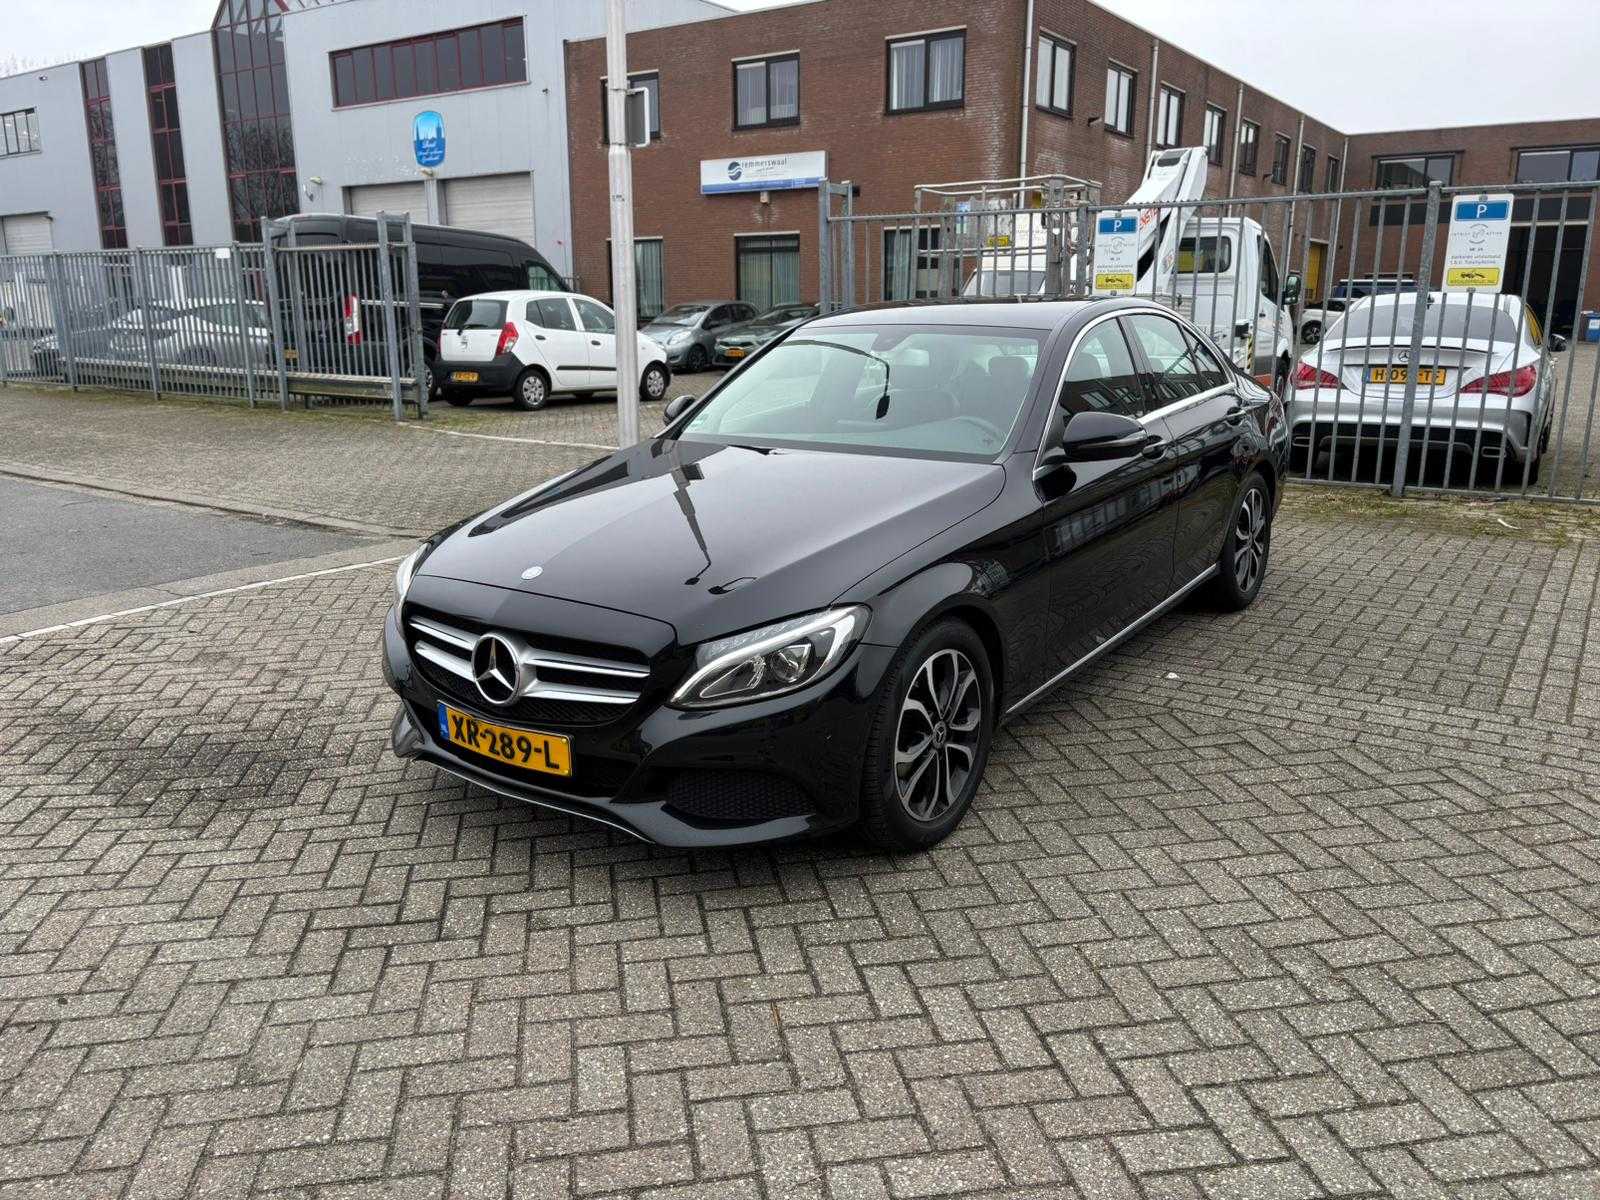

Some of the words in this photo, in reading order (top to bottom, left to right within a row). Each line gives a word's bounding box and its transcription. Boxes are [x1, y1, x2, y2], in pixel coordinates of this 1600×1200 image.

[1476, 204, 1488, 219] P
[1113, 219, 1123, 232] P
[451, 714, 560, 769] XR-289-L
